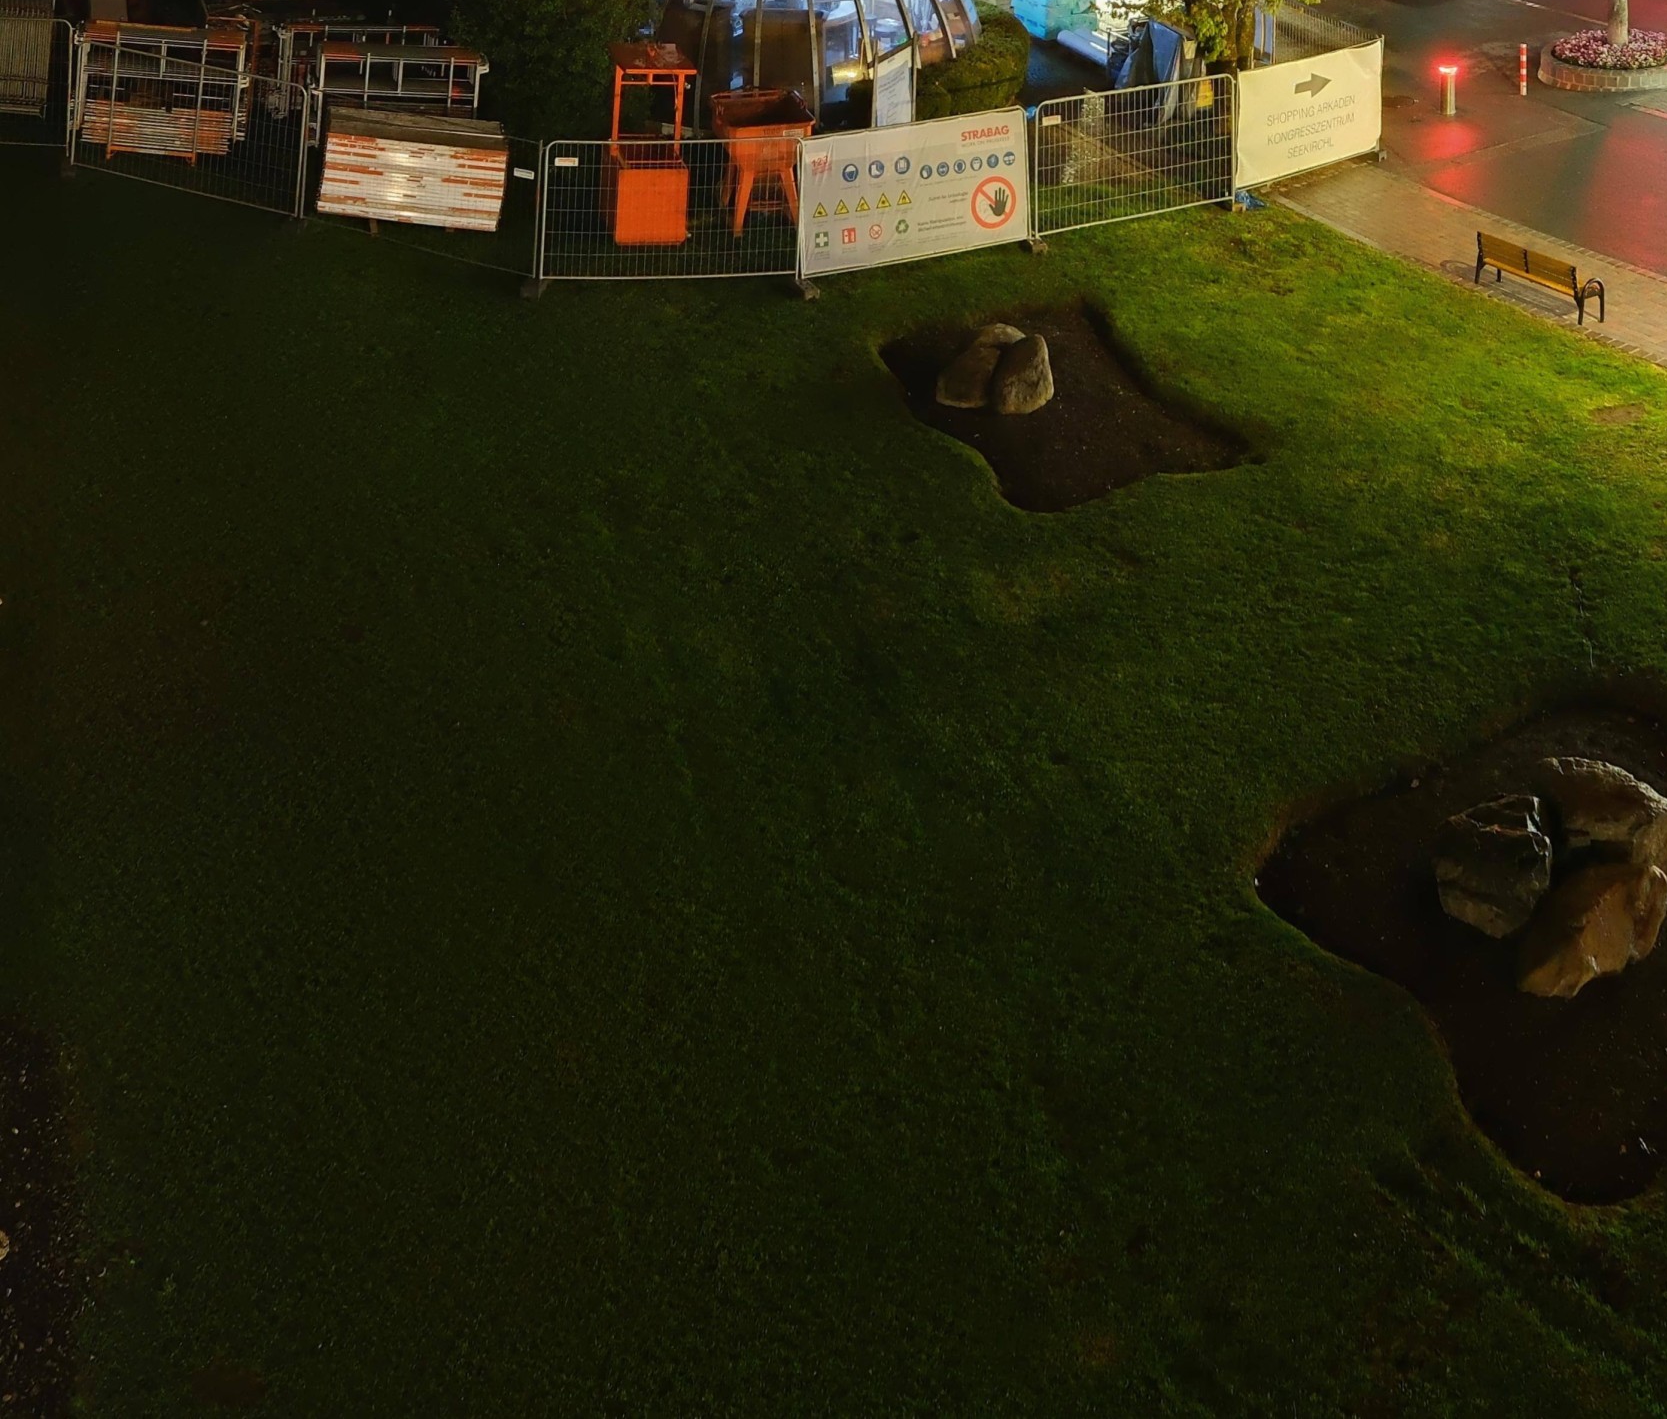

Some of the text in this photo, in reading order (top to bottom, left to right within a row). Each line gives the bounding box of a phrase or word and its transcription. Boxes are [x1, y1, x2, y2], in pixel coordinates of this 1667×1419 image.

[1266, 95, 1356, 127] SHOPPING ARKADEN
[961, 125, 1009, 141] STRABAG
[1267, 113, 1355, 145] KONGRESSZENTRUM
[1287, 137, 1334, 159] SEEKIRCHL
